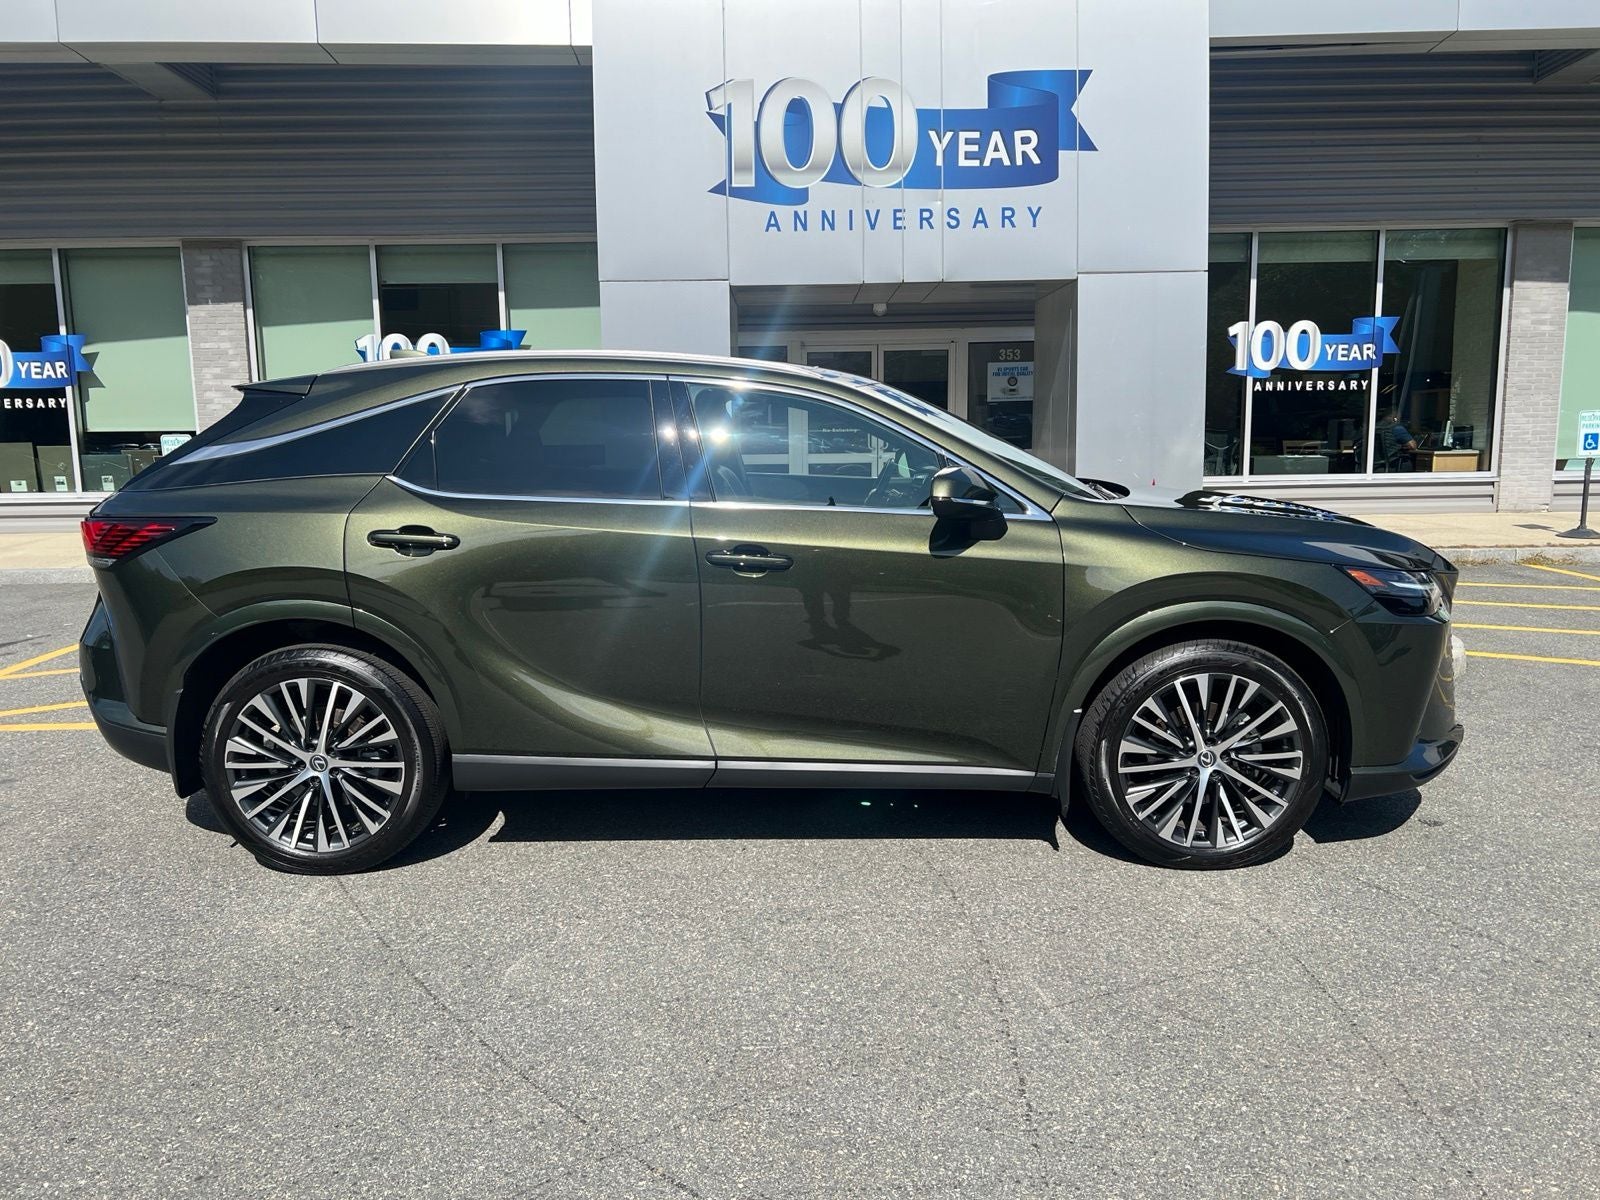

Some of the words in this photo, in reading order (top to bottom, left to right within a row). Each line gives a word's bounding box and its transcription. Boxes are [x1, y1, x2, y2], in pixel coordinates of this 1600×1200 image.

[706, 76, 919, 189] 100
[928, 128, 1042, 168] YEAR
[764, 205, 1044, 233] ANNIVERSARY
[999, 349, 1021, 360] 353
[1227, 319, 1322, 371] 100
[1325, 343, 1377, 363] YEAR
[16, 361, 69, 379] YEAR
[1253, 379, 1370, 392] ANNIVERSARY
